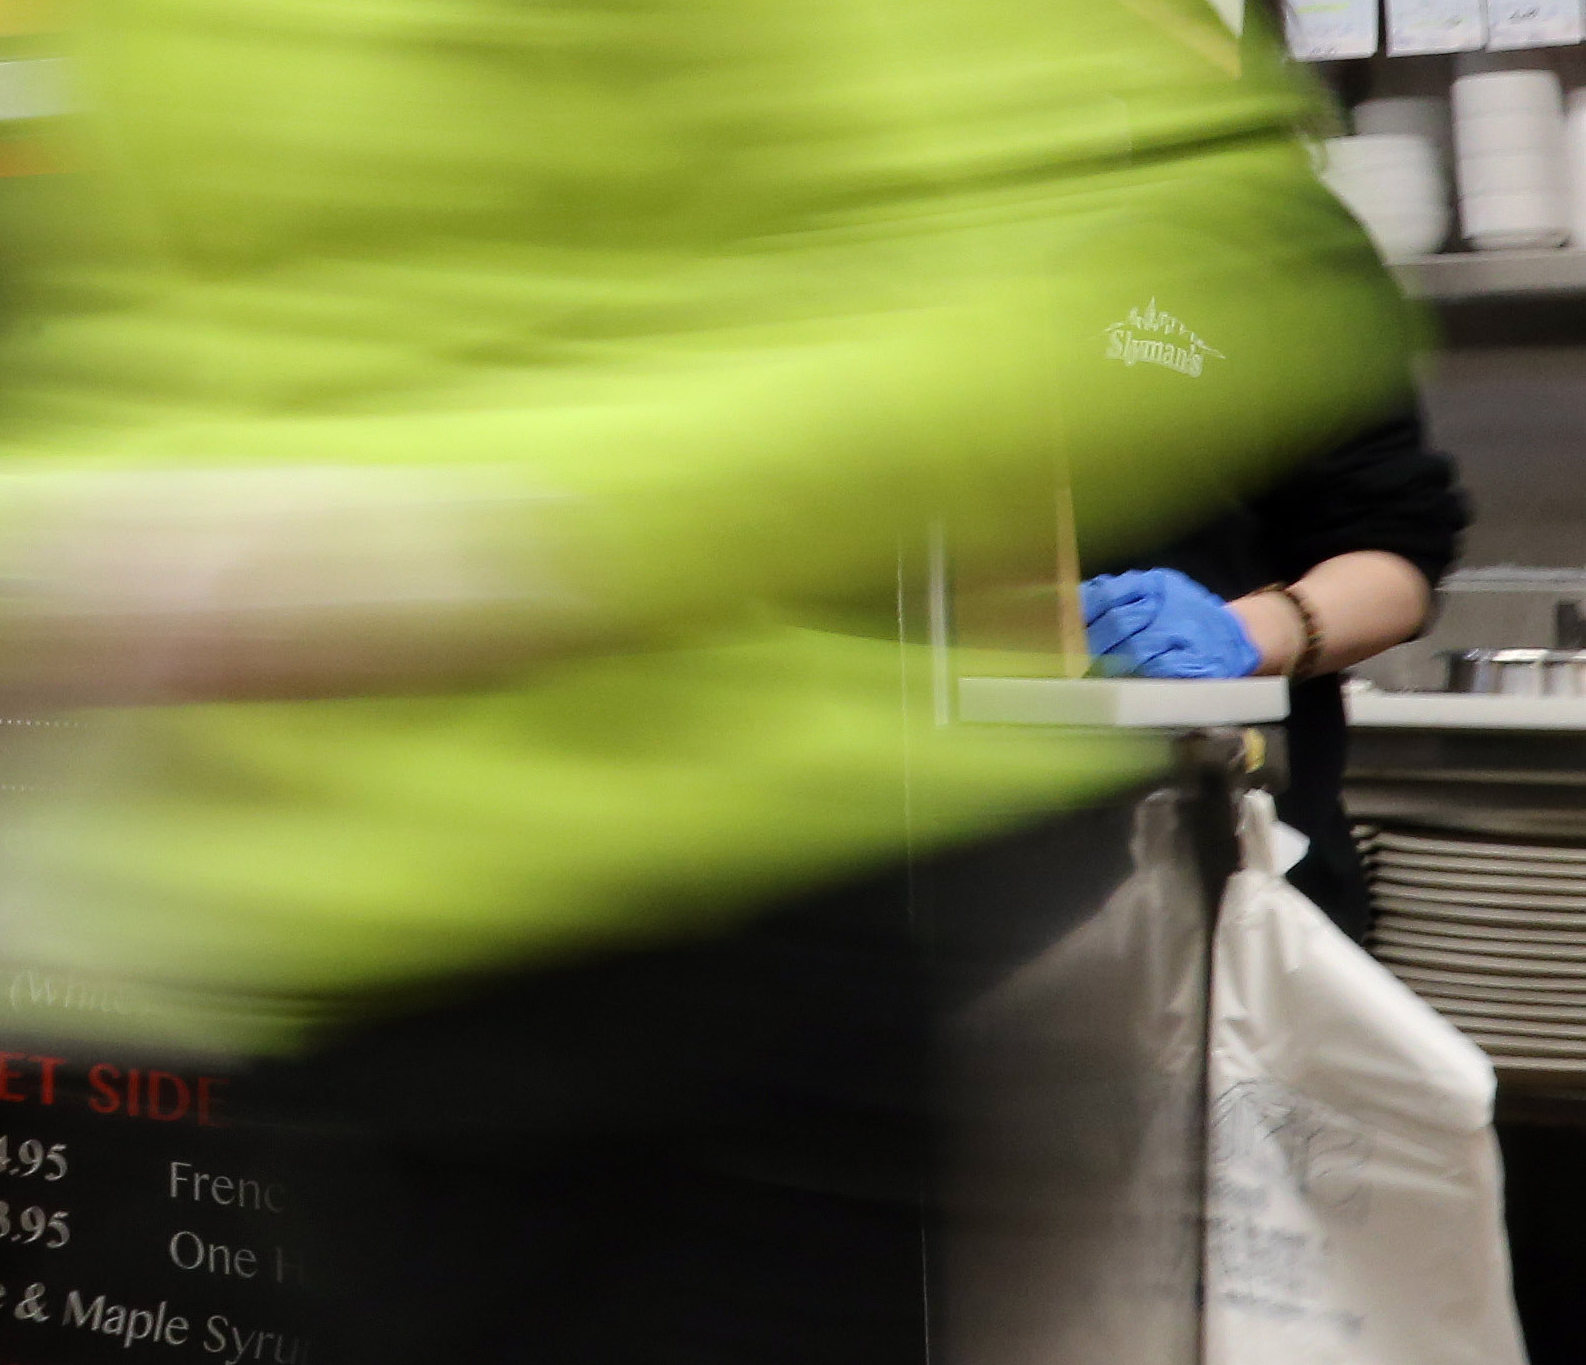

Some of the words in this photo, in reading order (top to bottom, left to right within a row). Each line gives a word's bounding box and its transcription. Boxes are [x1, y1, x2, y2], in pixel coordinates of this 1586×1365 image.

[88, 1062, 231, 1127] SIDE
[170, 1231, 258, 1279] One
[15, 1282, 50, 1325] &
[63, 1290, 189, 1348] Maple
